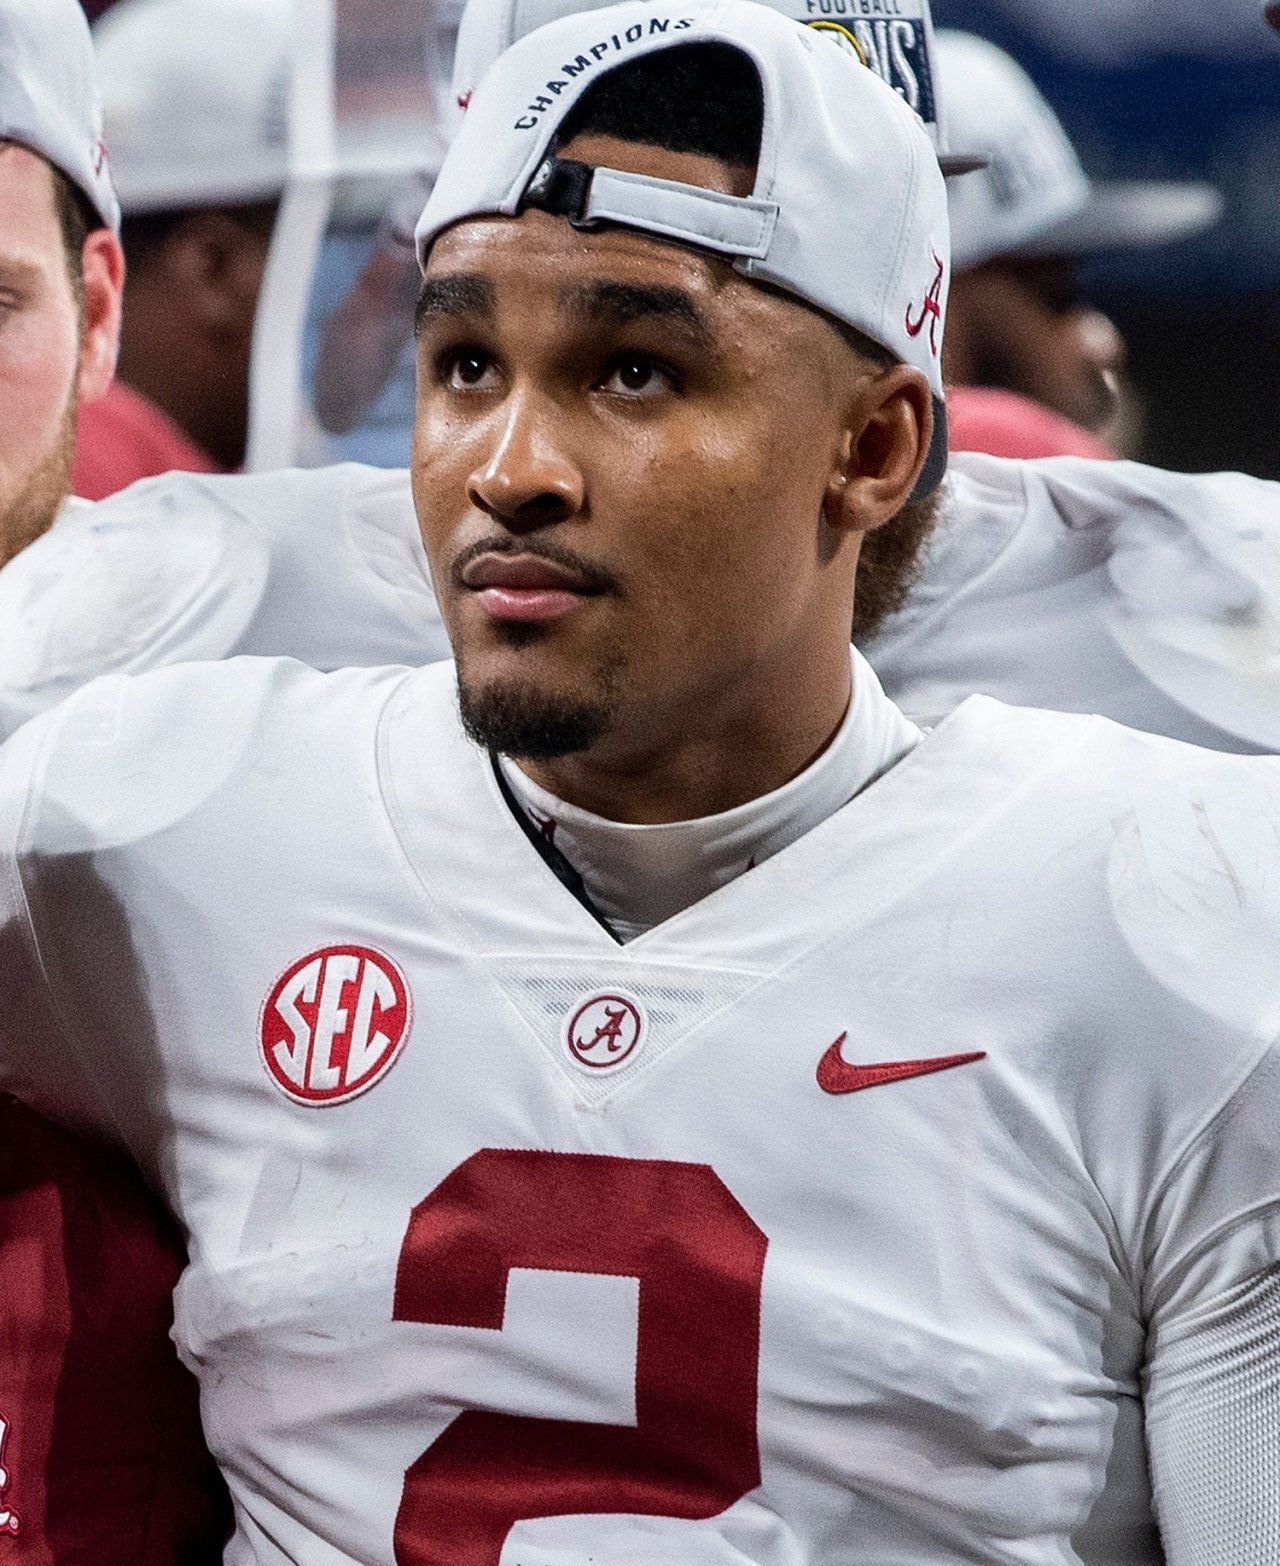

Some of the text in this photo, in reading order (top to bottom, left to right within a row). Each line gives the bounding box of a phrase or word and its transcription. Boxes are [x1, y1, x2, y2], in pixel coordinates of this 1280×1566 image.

[514, 18, 695, 130] CHAMPIONS
[271, 952, 397, 1091] SEC
[392, 1147, 769, 1566] 2
